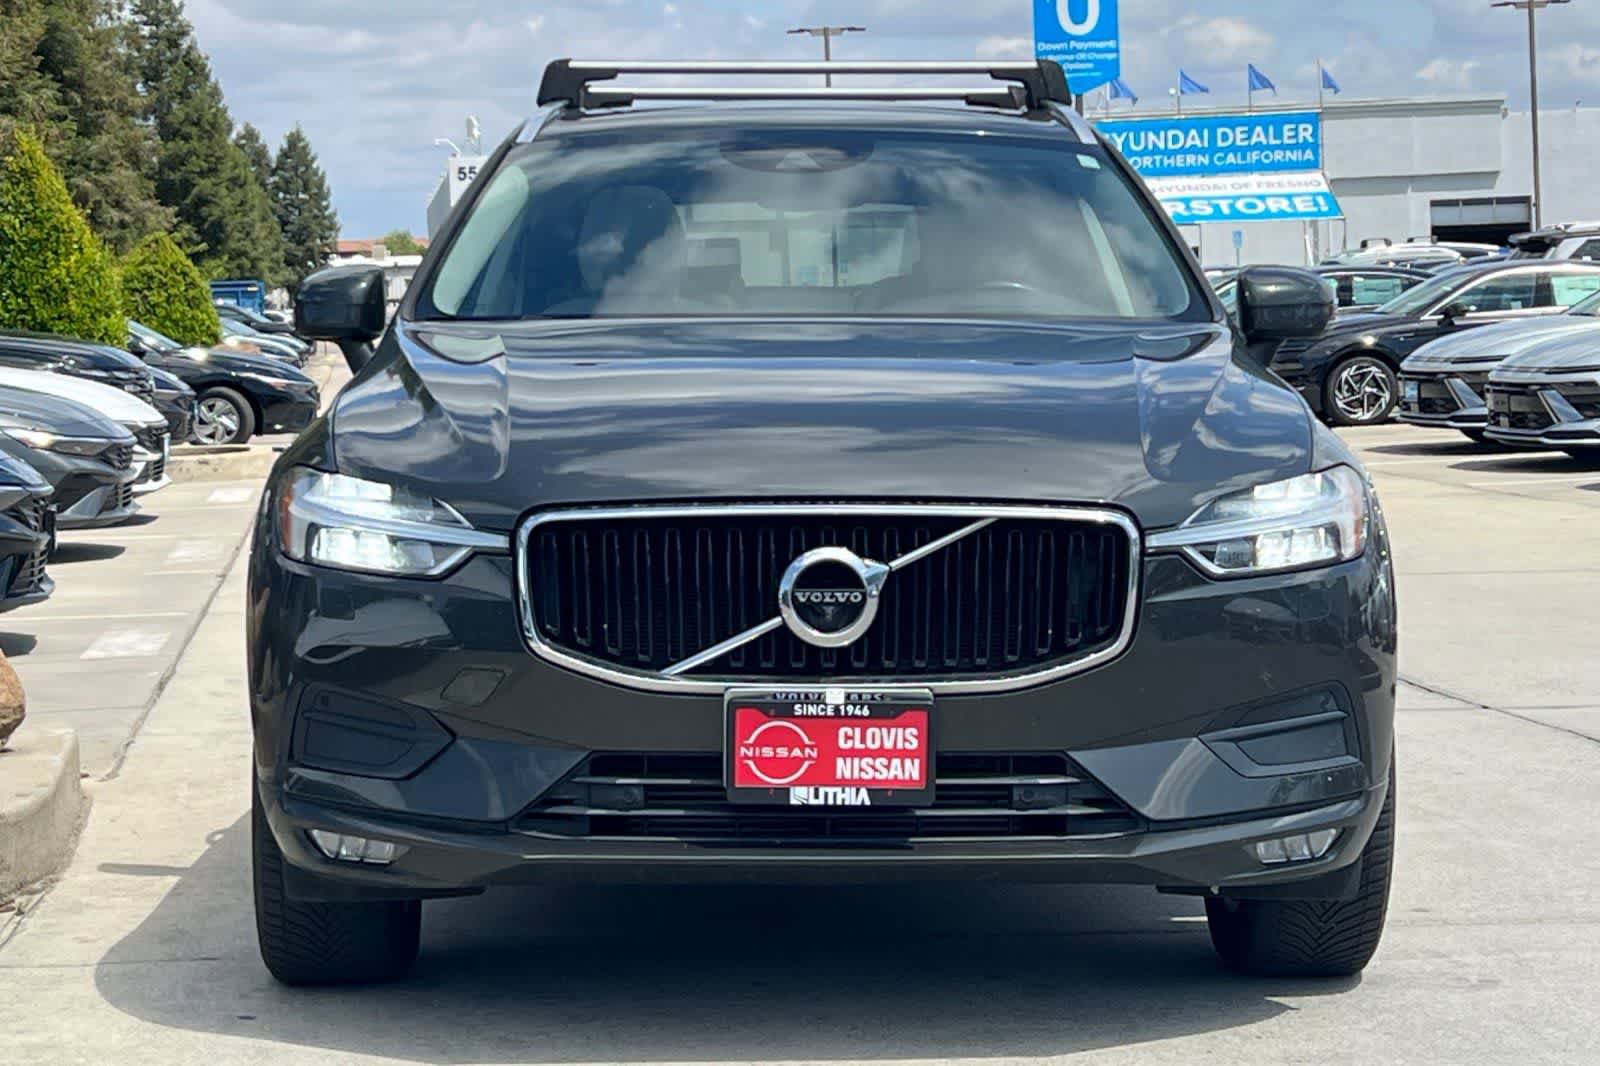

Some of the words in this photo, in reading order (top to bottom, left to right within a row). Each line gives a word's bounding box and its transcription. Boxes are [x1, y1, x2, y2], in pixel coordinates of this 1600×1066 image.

[1104, 127, 1209, 153] YUNDAI
[1216, 123, 1314, 148] DEALER
[1213, 148, 1315, 166] CALIFORNIA
[794, 592, 863, 603] VOLVO
[793, 704, 835, 716] SINCE
[839, 704, 871, 716] 1946
[837, 726, 919, 750] CLOVIS
[739, 746, 818, 759] NISSAN
[835, 756, 920, 780] NISSAN
[808, 786, 872, 806] LITHIA
